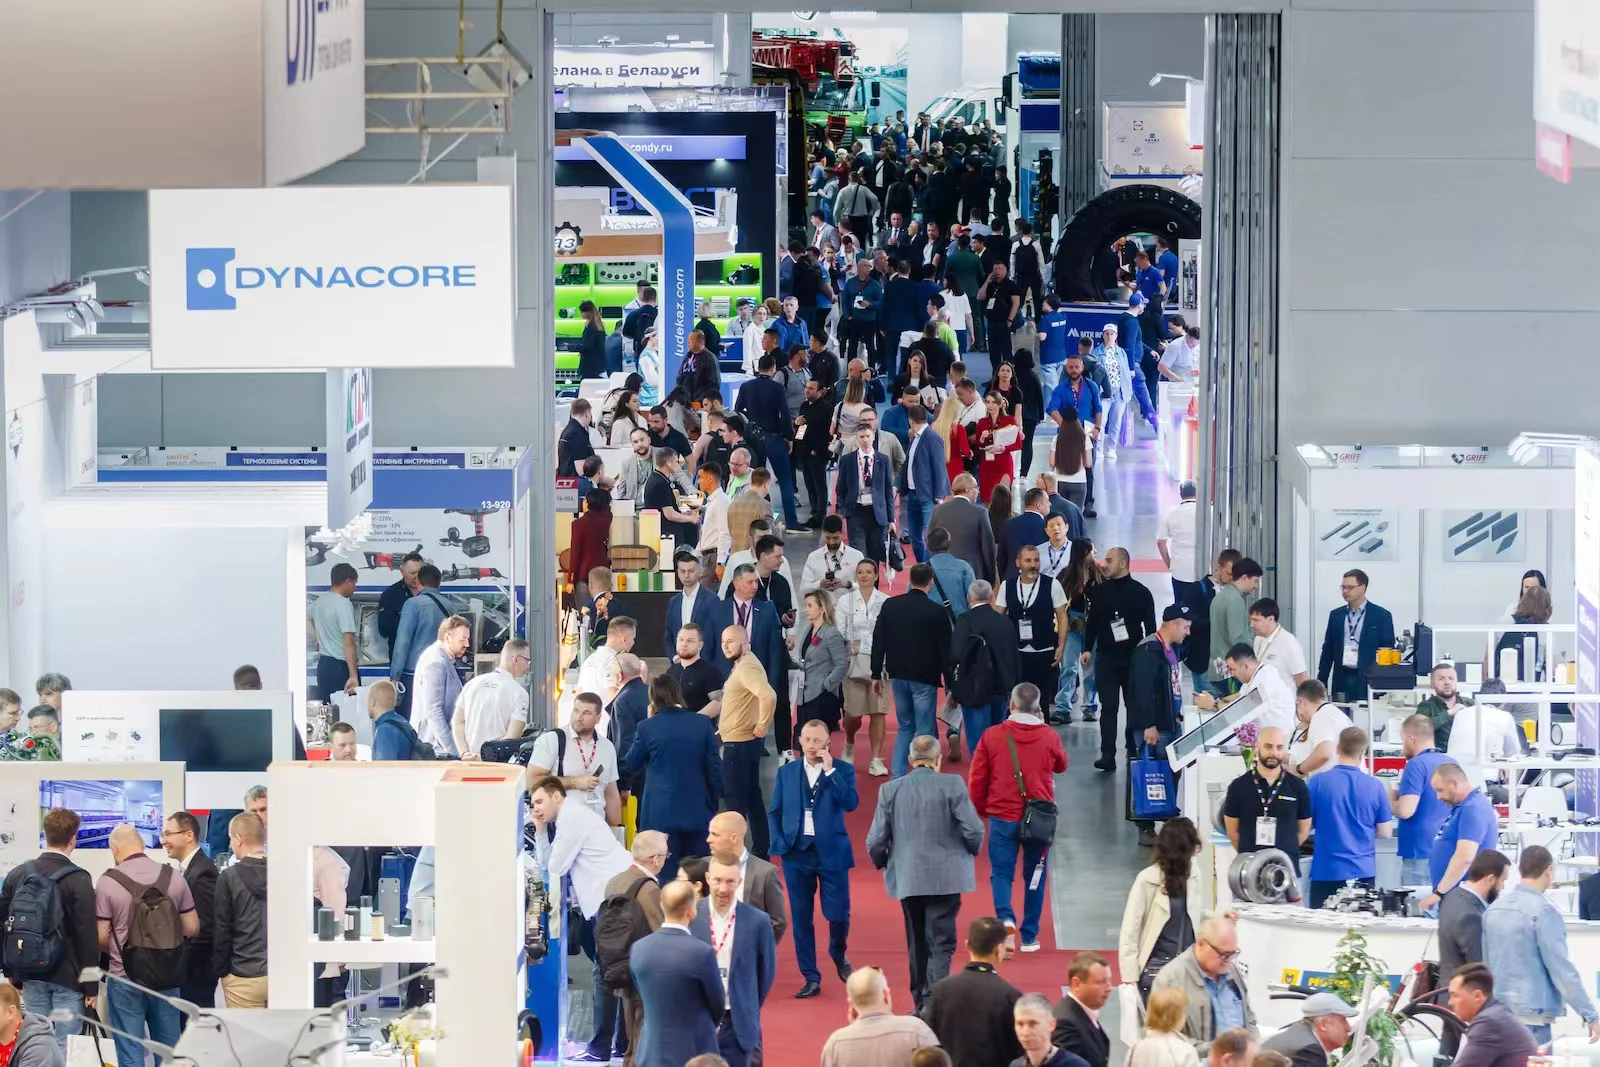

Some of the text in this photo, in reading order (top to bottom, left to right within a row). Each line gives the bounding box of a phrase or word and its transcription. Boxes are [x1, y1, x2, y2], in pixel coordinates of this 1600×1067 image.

[605, 66, 614, 76] в
[618, 64, 699, 79] Беларуси
[628, 142, 673, 153] condy.ru
[235, 265, 477, 289] DYNACORE
[674, 268, 685, 357] ludekaz.com
[1339, 453, 1361, 461] GRIFF
[1465, 454, 1488, 462] GRIFF
[481, 500, 511, 509] 13-920
